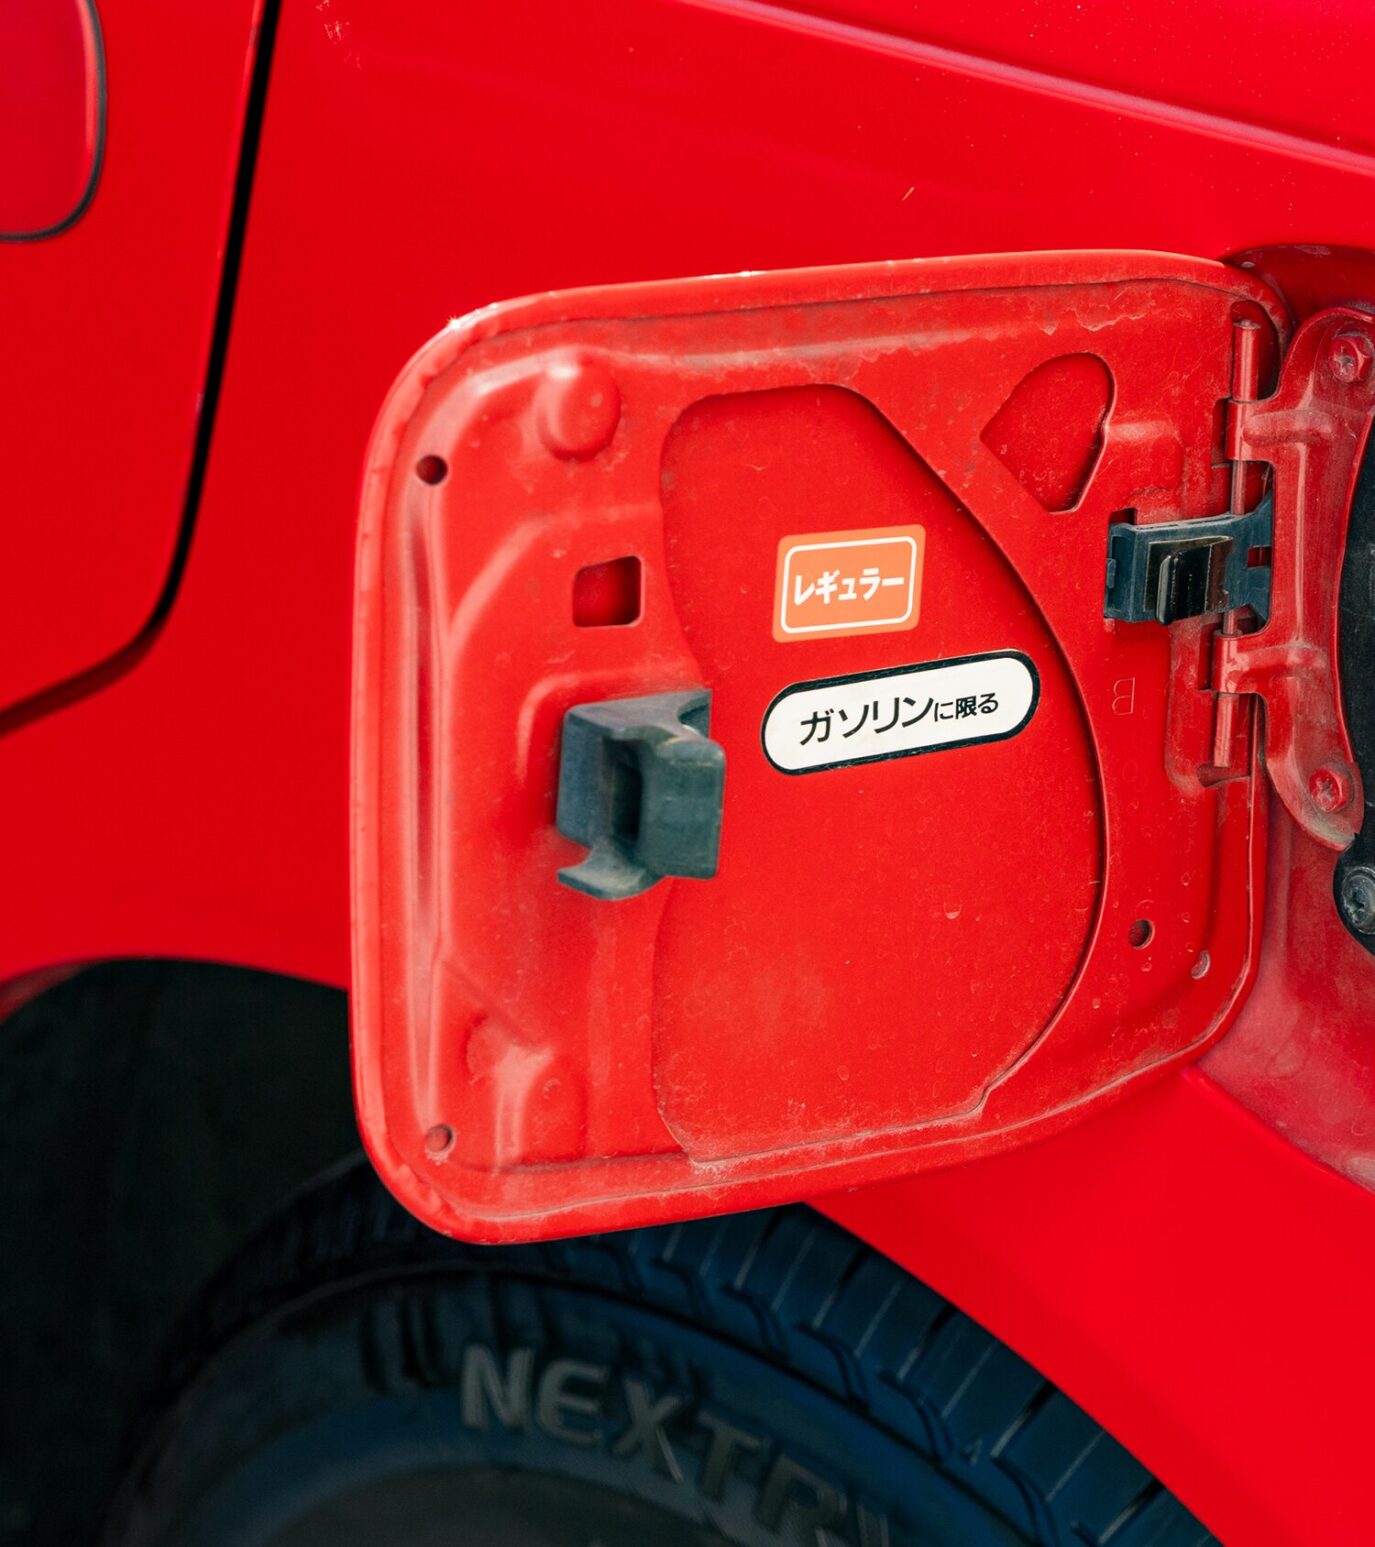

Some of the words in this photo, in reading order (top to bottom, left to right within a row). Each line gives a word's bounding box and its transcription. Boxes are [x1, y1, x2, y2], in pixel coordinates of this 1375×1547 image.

[794, 567, 905, 606] レギュラー
[799, 692, 999, 746] ガソリンに限る
